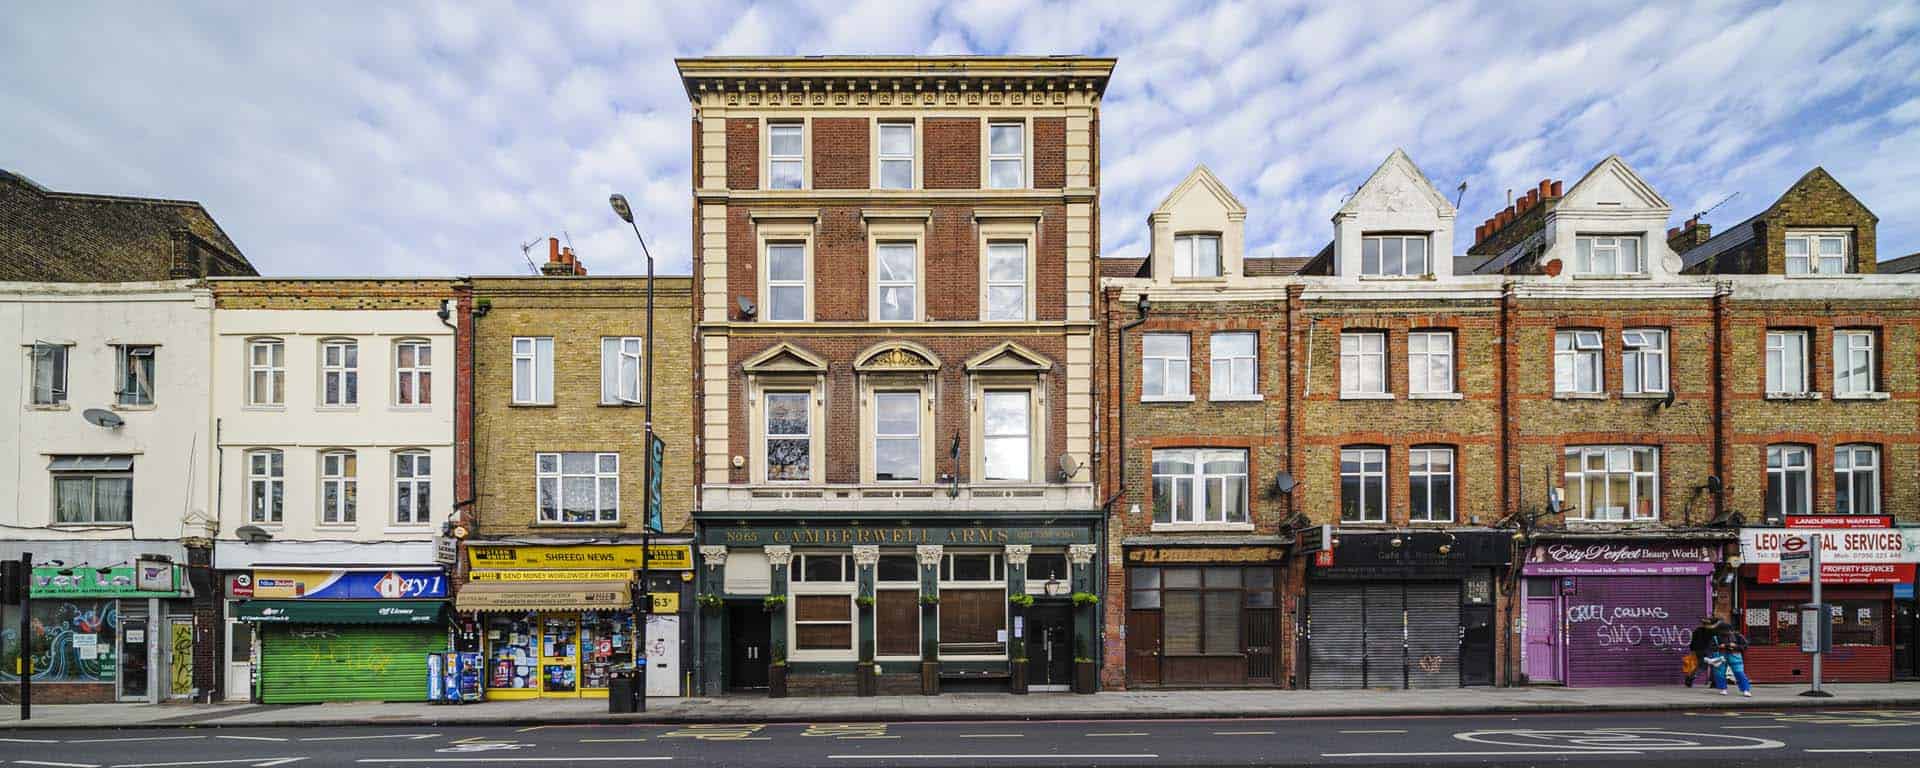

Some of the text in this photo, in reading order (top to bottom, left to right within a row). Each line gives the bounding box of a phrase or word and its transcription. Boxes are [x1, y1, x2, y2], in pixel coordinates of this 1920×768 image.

[773, 529, 932, 544] CAMBERWELL
[946, 529, 1009, 544] ARMS
[1844, 534, 1903, 550] SERVICES
[587, 552, 615, 561] NEWS
[1585, 545, 1642, 562] Perfect
[1642, 549, 1670, 560] Beauty
[1672, 548, 1699, 559] World
[1823, 565, 1894, 573] PROPERTY SERVICES
[1568, 604, 1613, 625] CRUEL
[1597, 624, 1693, 646] SIMO SIMO
